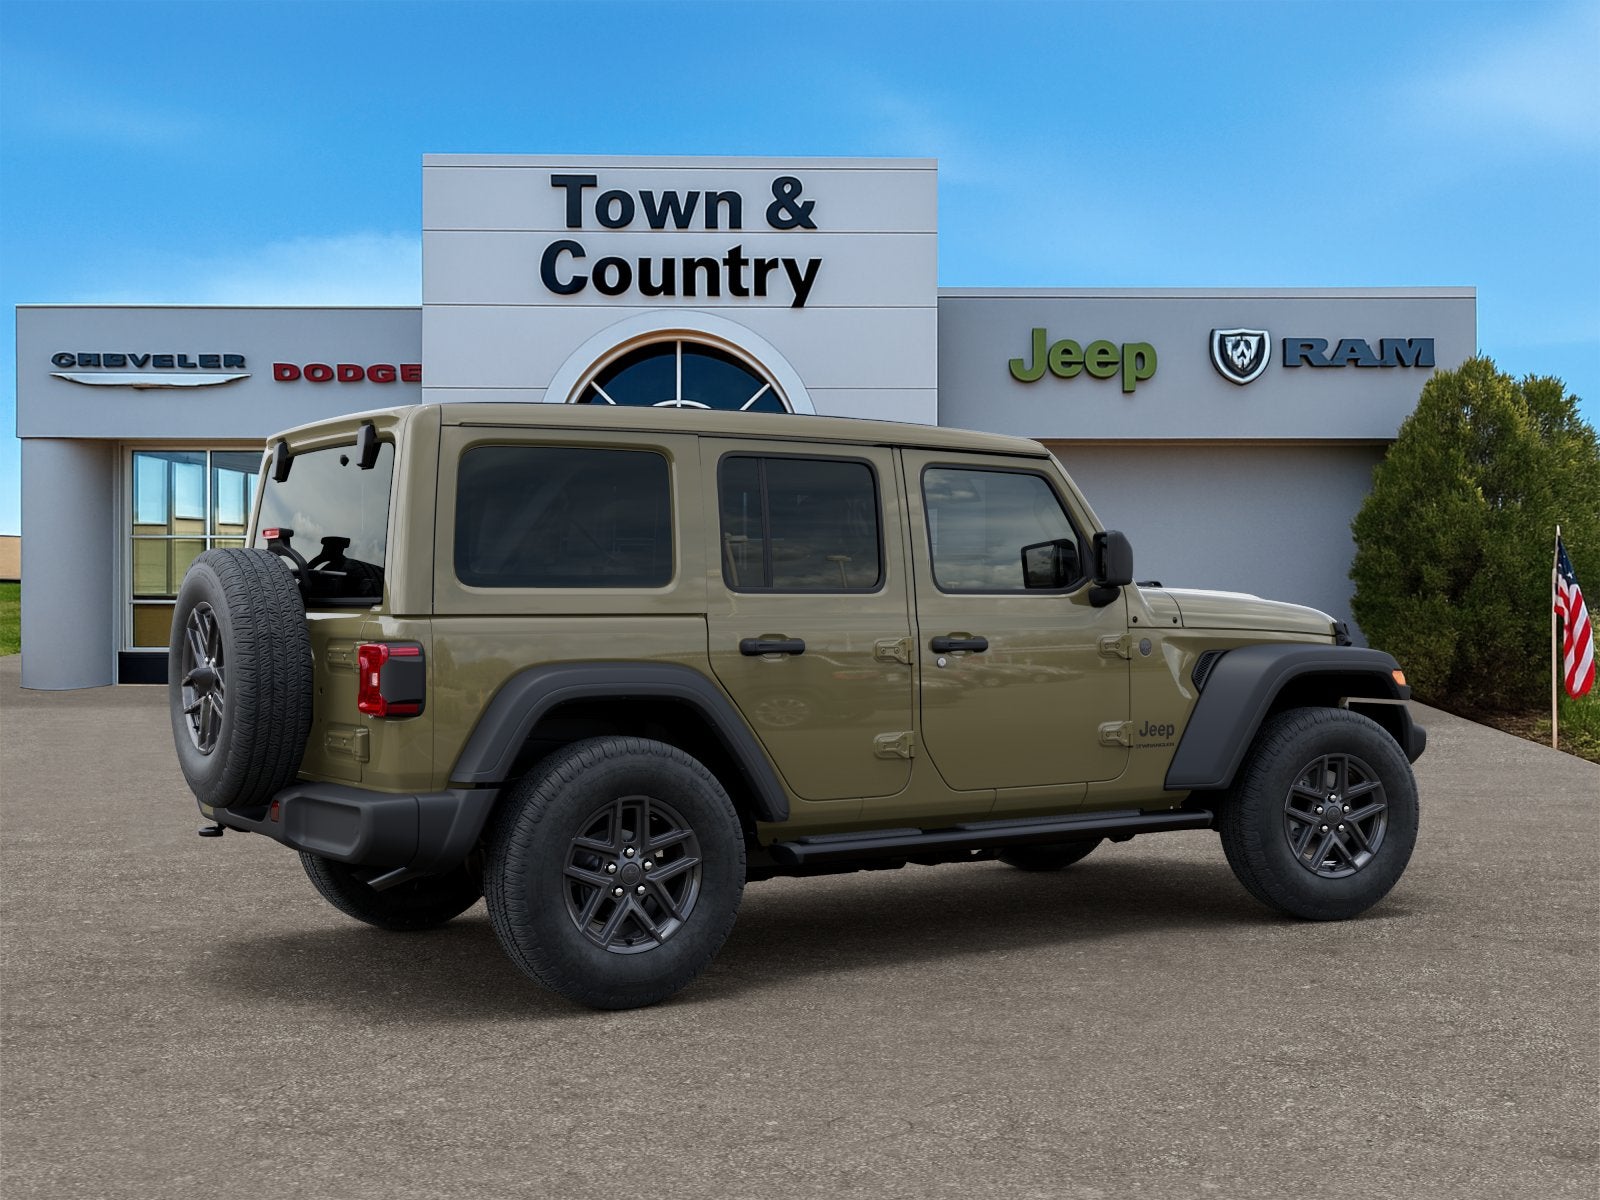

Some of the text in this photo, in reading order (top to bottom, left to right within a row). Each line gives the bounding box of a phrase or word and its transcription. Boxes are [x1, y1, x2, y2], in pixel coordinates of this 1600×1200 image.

[550, 174, 818, 230] Town &
[539, 239, 823, 308] Country
[272, 362, 422, 383] DODGE
[1009, 328, 1158, 393] Jeep
[1283, 337, 1436, 368] RAM
[1139, 720, 1175, 739] Jeep
